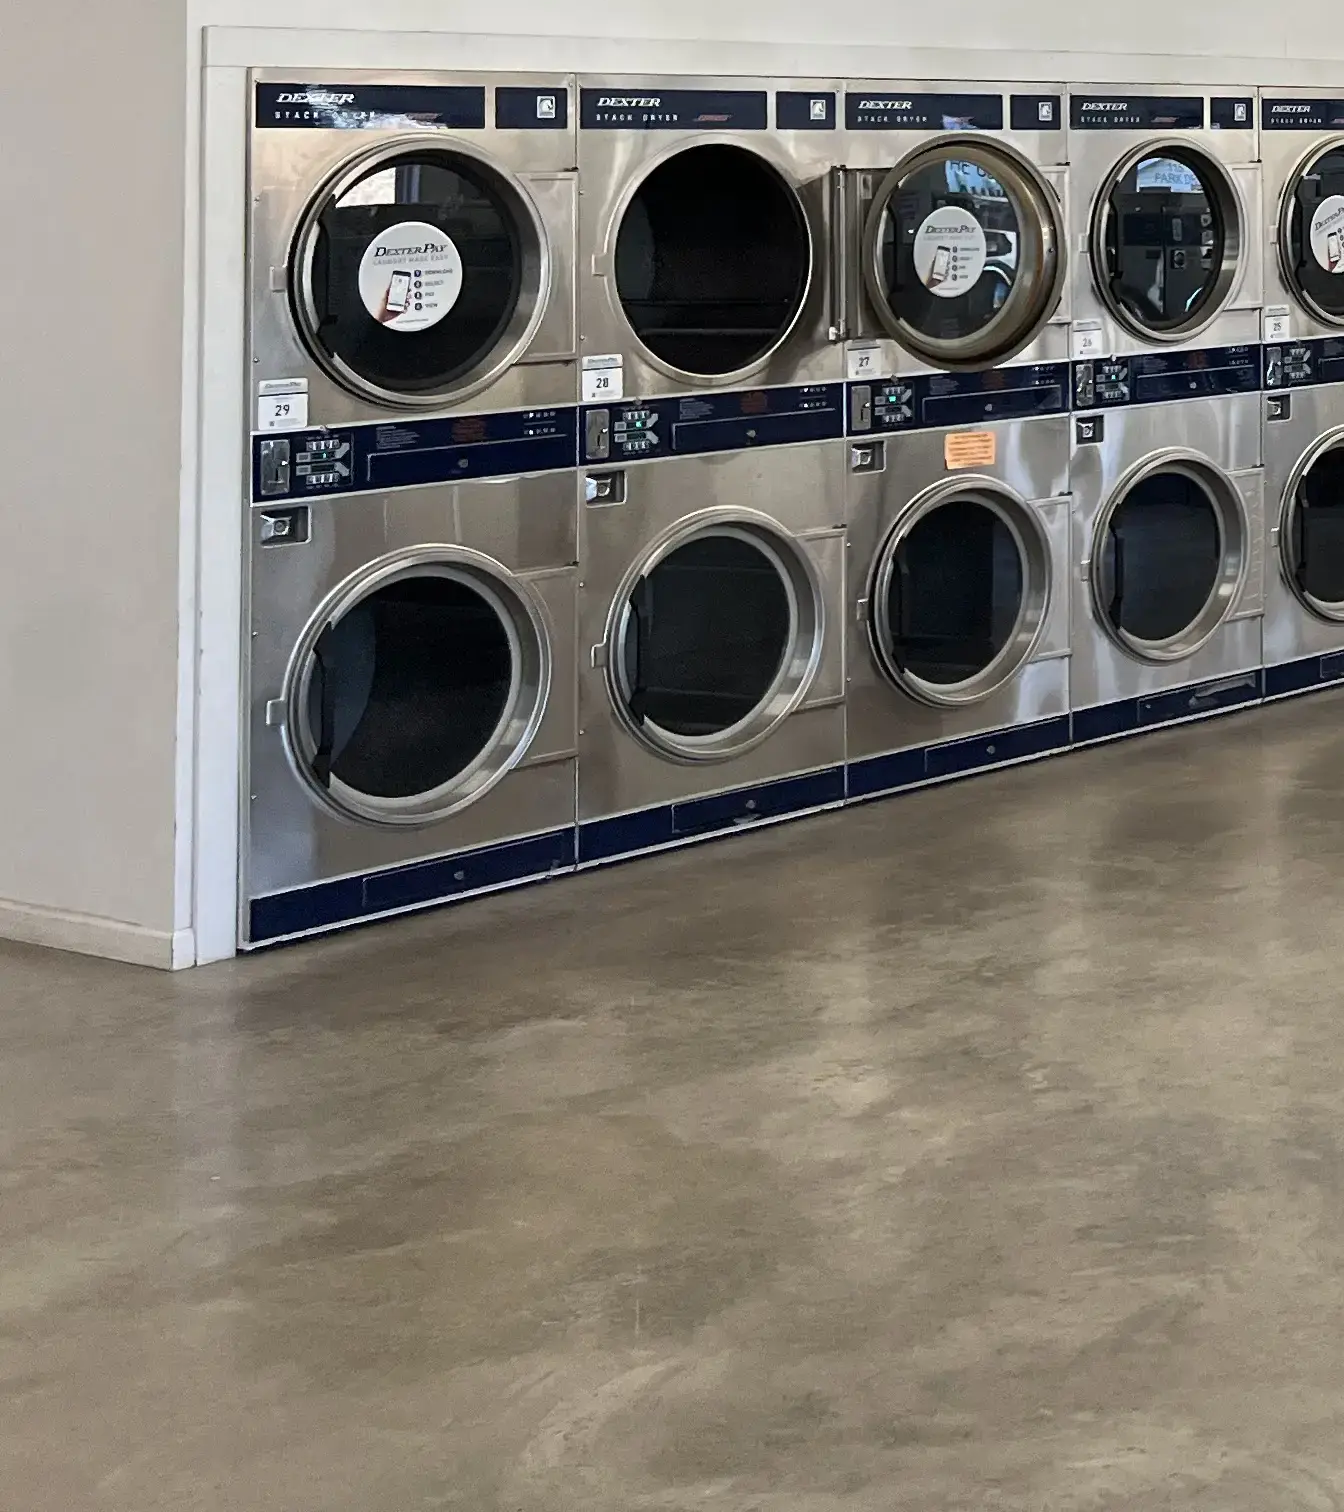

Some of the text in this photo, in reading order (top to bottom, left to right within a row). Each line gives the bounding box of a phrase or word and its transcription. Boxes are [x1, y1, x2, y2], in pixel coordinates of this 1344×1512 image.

[276, 92, 355, 104] DEXTER
[597, 97, 661, 107] DEXTER
[858, 100, 913, 110] DEXTER
[1081, 102, 1127, 111] DEXTER
[1271, 105, 1311, 113] DEXTER
[858, 356, 870, 367] 27
[596, 377, 609, 389] 28
[275, 404, 290, 416] 29
